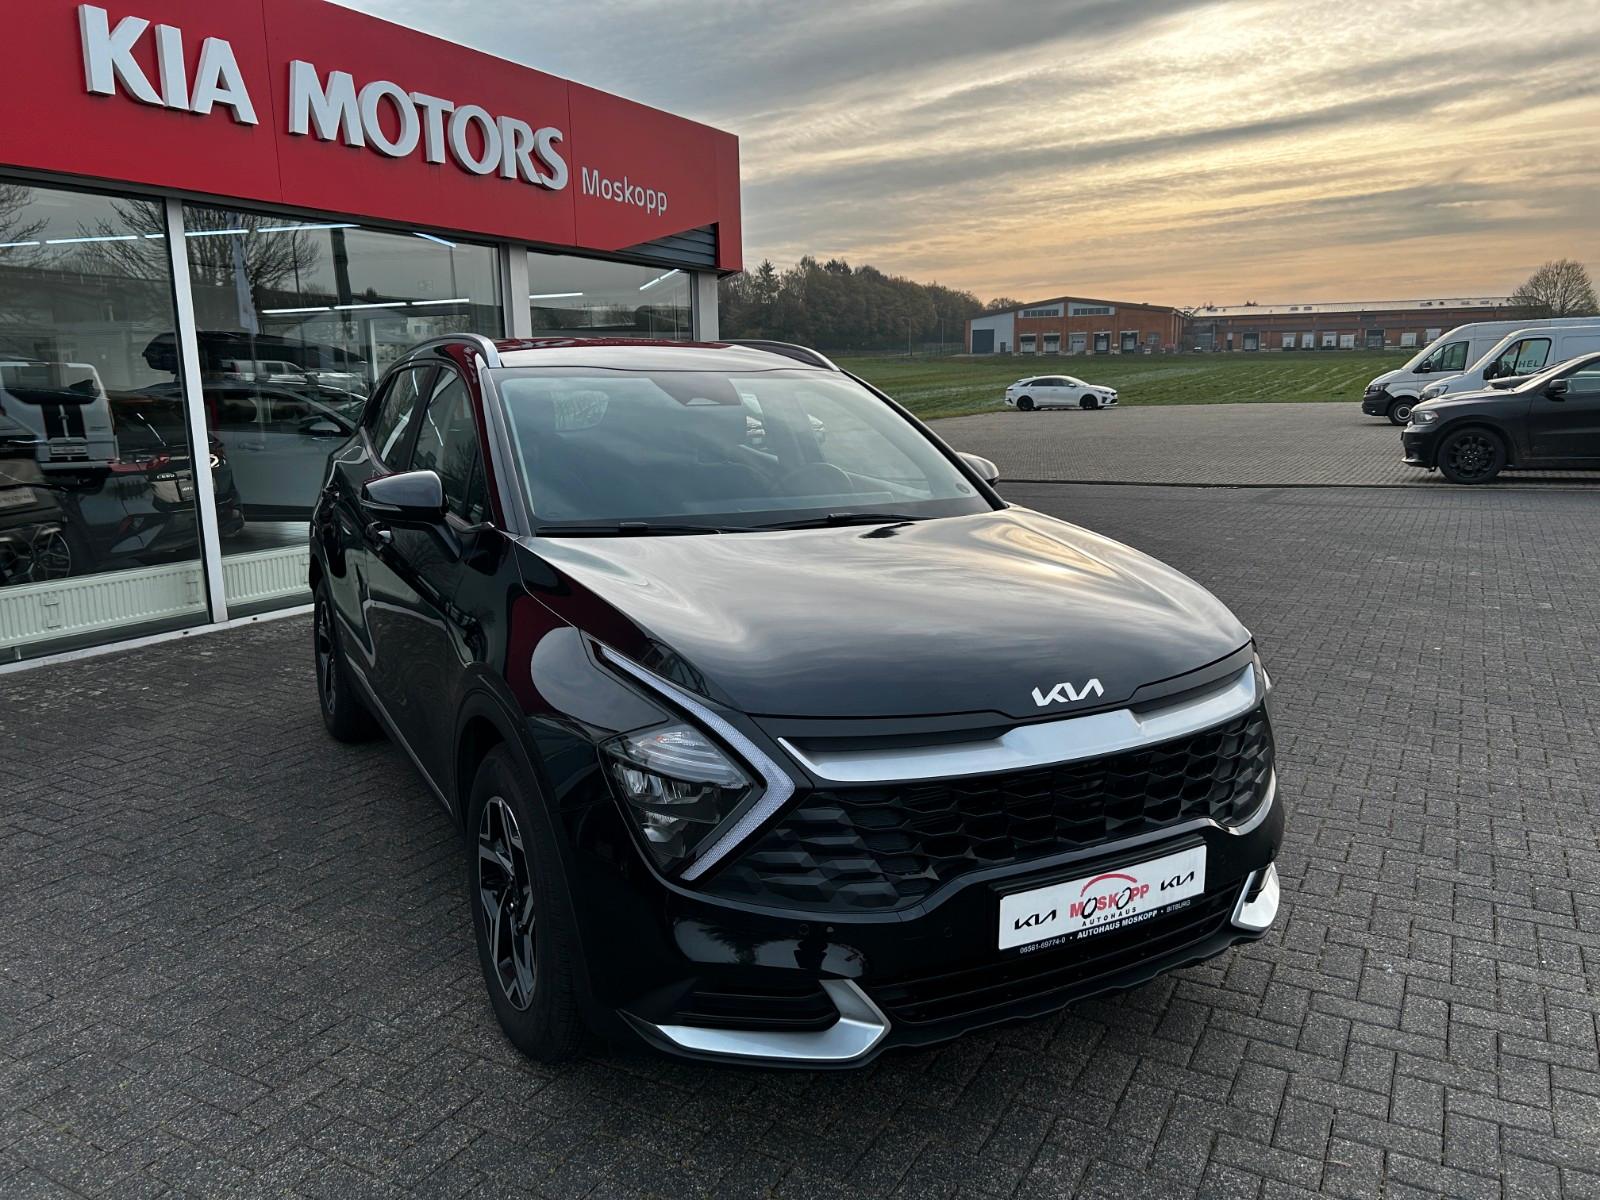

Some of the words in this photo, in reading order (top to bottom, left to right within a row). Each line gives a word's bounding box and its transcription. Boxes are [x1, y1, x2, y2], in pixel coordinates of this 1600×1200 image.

[78, 4, 259, 125] KIA
[288, 59, 569, 190] MOTORS
[581, 166, 668, 217] Moskopp
[1031, 678, 1104, 706] KIA
[1160, 871, 1195, 891] KIA
[1069, 883, 1150, 919] MOSKOPP
[1014, 909, 1057, 930] KIA
[1076, 921, 1120, 940] AUTOHAUS
[1121, 910, 1158, 927] MOSKOPP
[1081, 906, 1137, 927] AUTOHAUS
